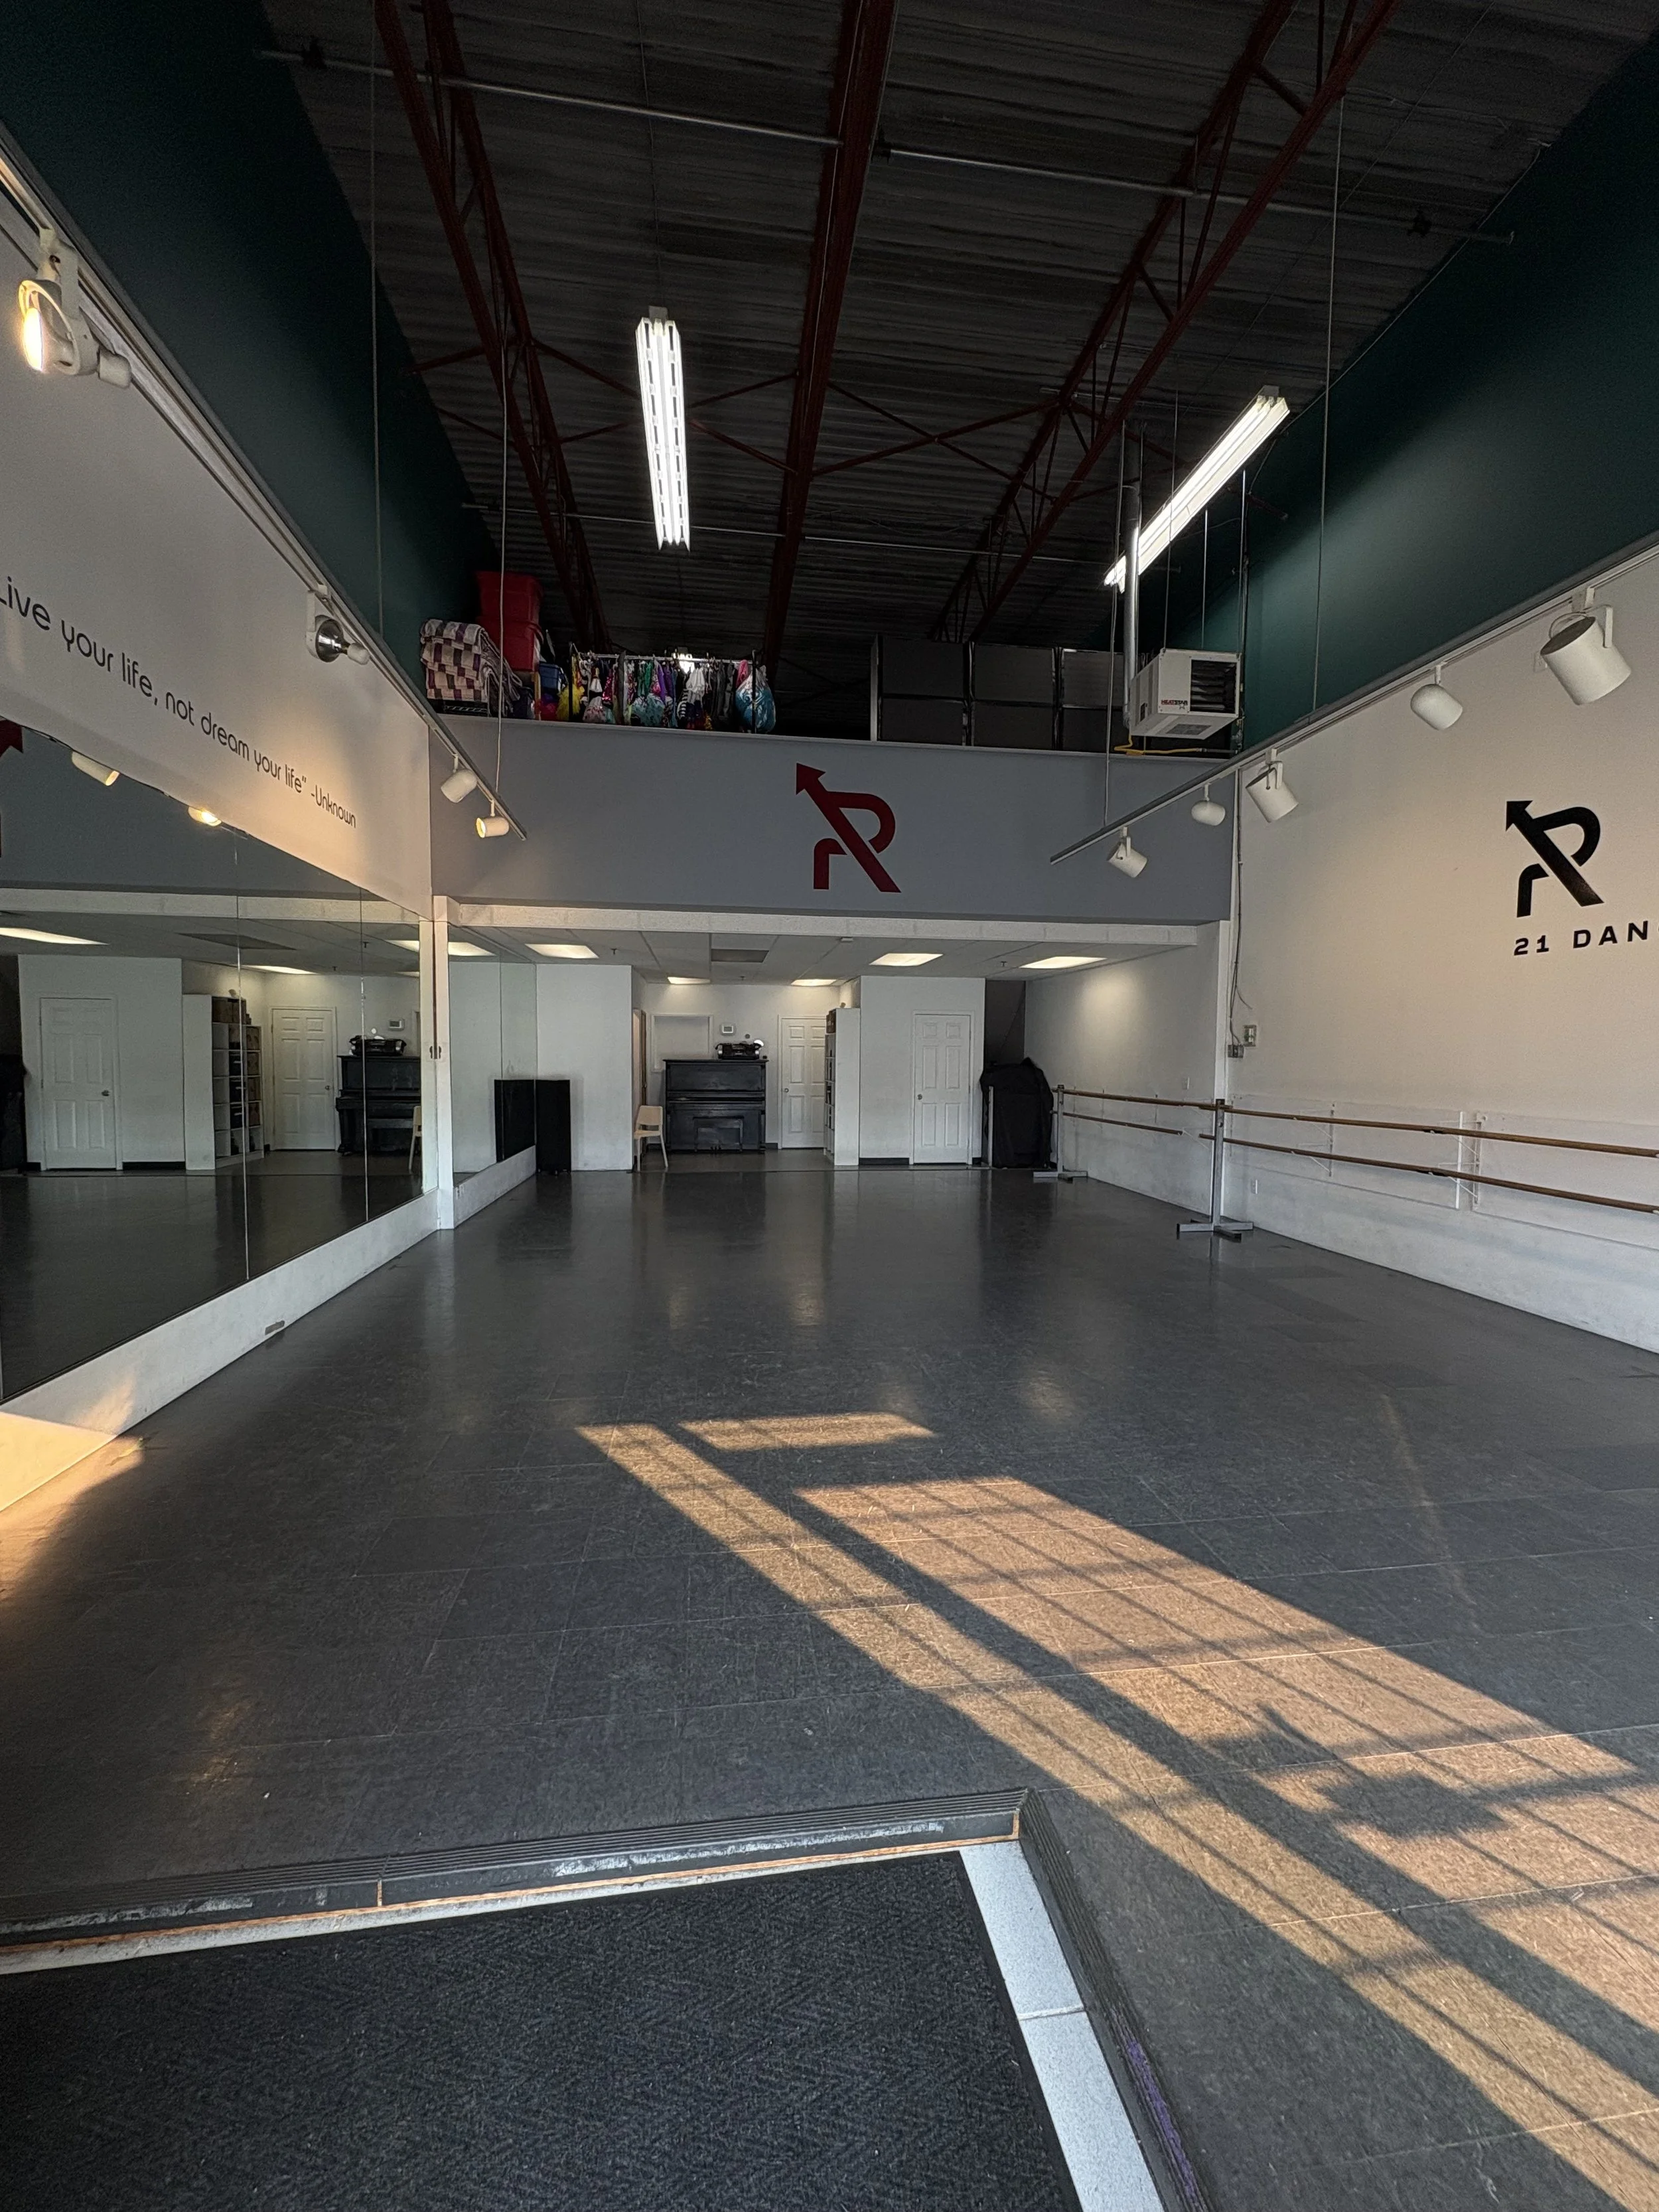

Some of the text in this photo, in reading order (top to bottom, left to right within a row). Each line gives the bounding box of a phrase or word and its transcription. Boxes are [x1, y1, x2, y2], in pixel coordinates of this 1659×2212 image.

[0, 576, 50, 630] ive
[61, 620, 113, 672] your
[122, 652, 157, 705] life,
[166, 692, 194, 726] not
[201, 712, 250, 761] dream
[254, 749, 281, 780] your
[1514, 921, 1659, 956] 21 DAN
